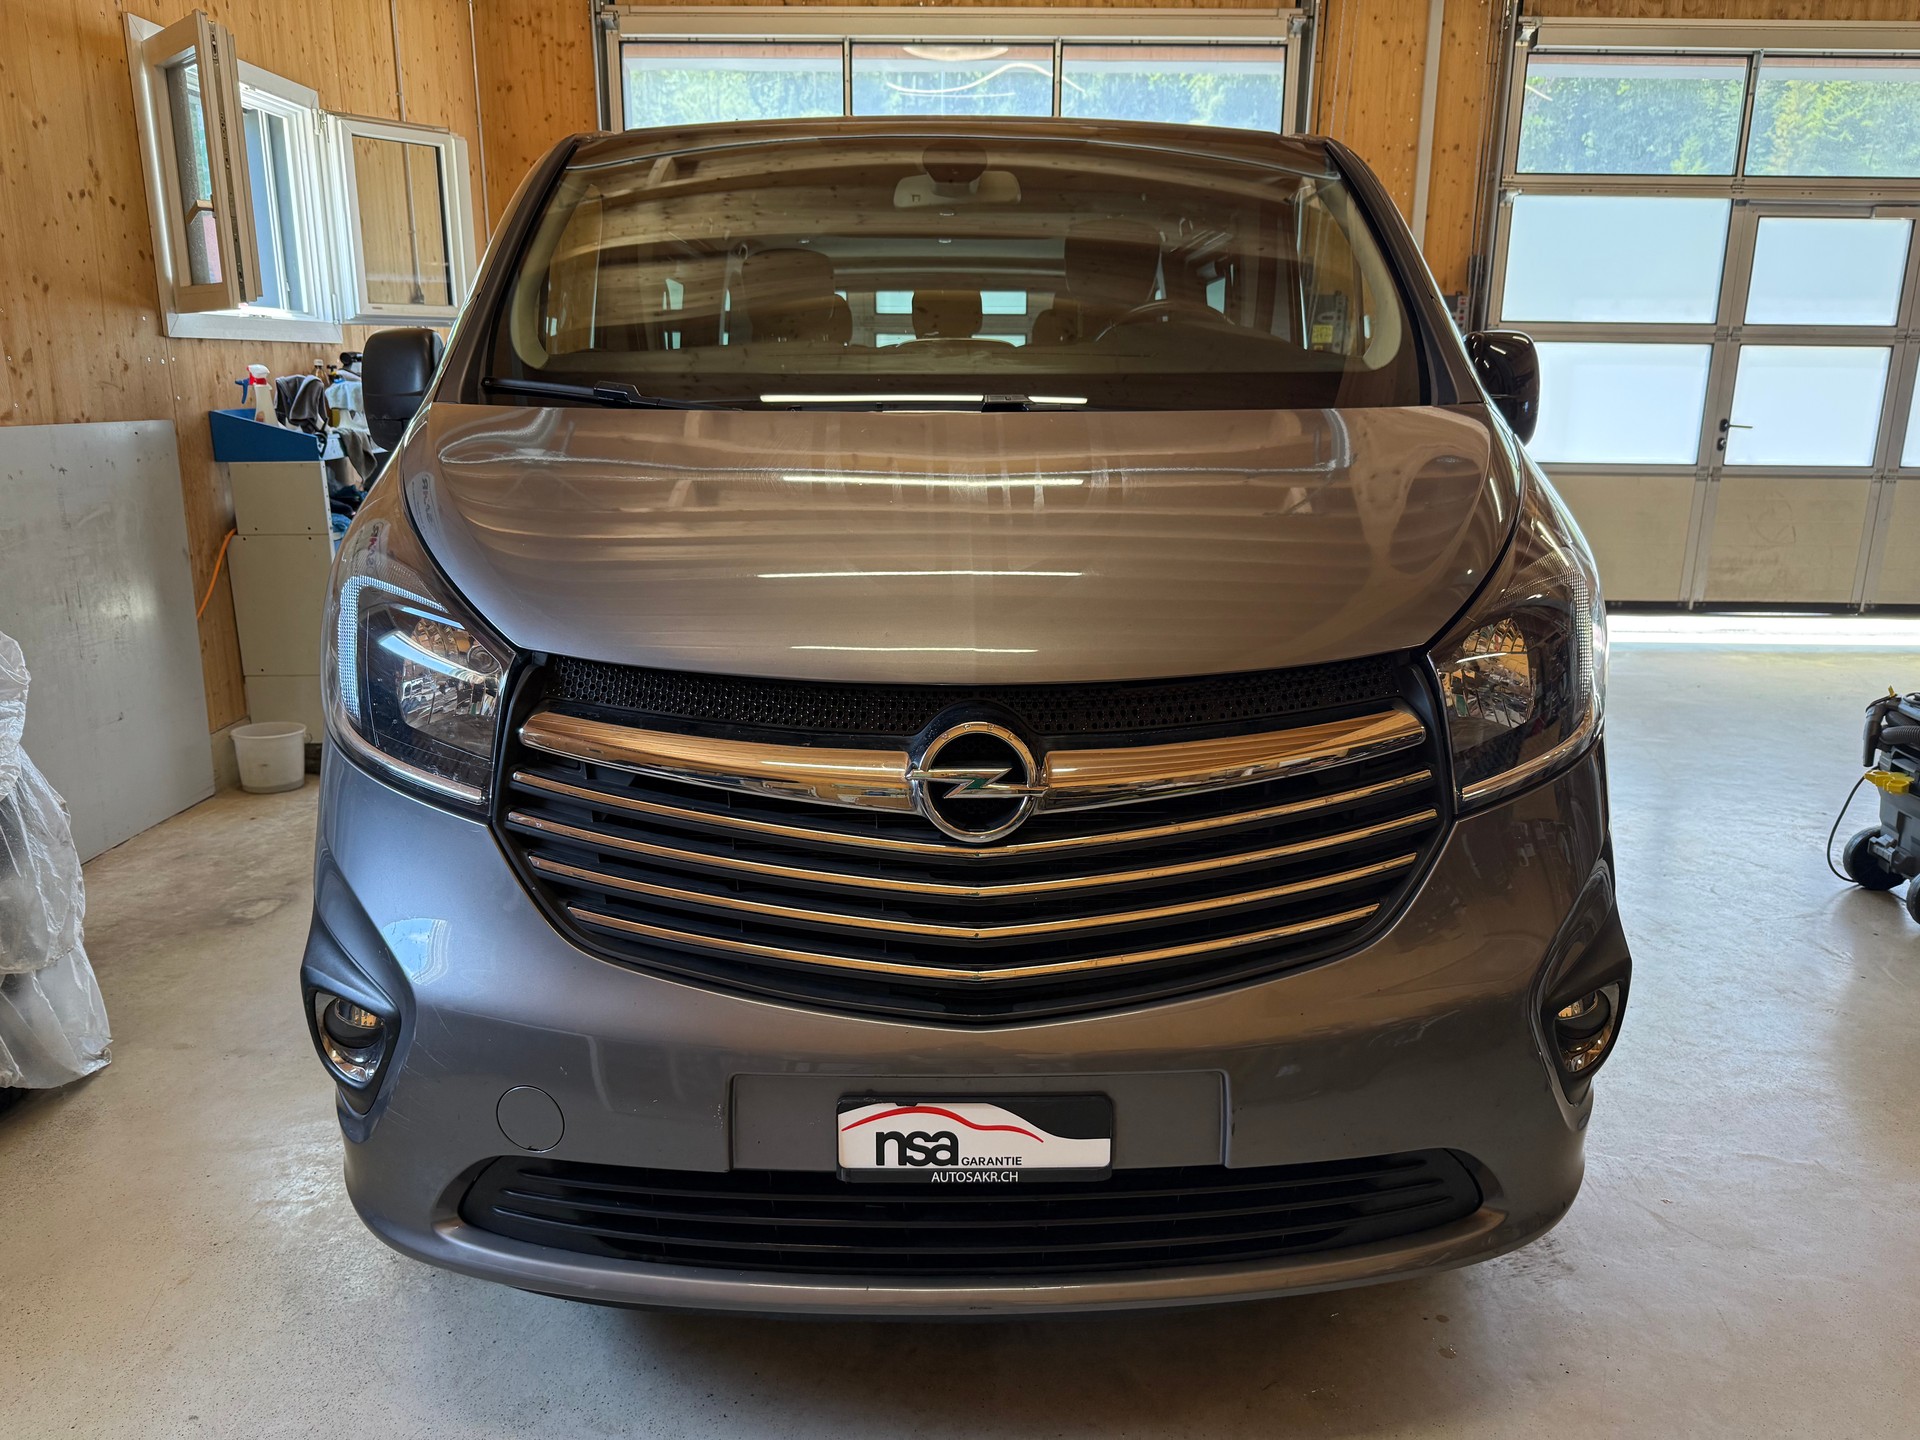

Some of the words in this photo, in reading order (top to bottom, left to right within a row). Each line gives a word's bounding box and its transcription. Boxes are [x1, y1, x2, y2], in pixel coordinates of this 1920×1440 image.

[941, 723, 1014, 741] OPEL
[876, 1130, 959, 1167] nsa
[961, 1156, 1023, 1166] GARANTIE
[931, 1171, 1019, 1183] AUTOSAKR.CH
